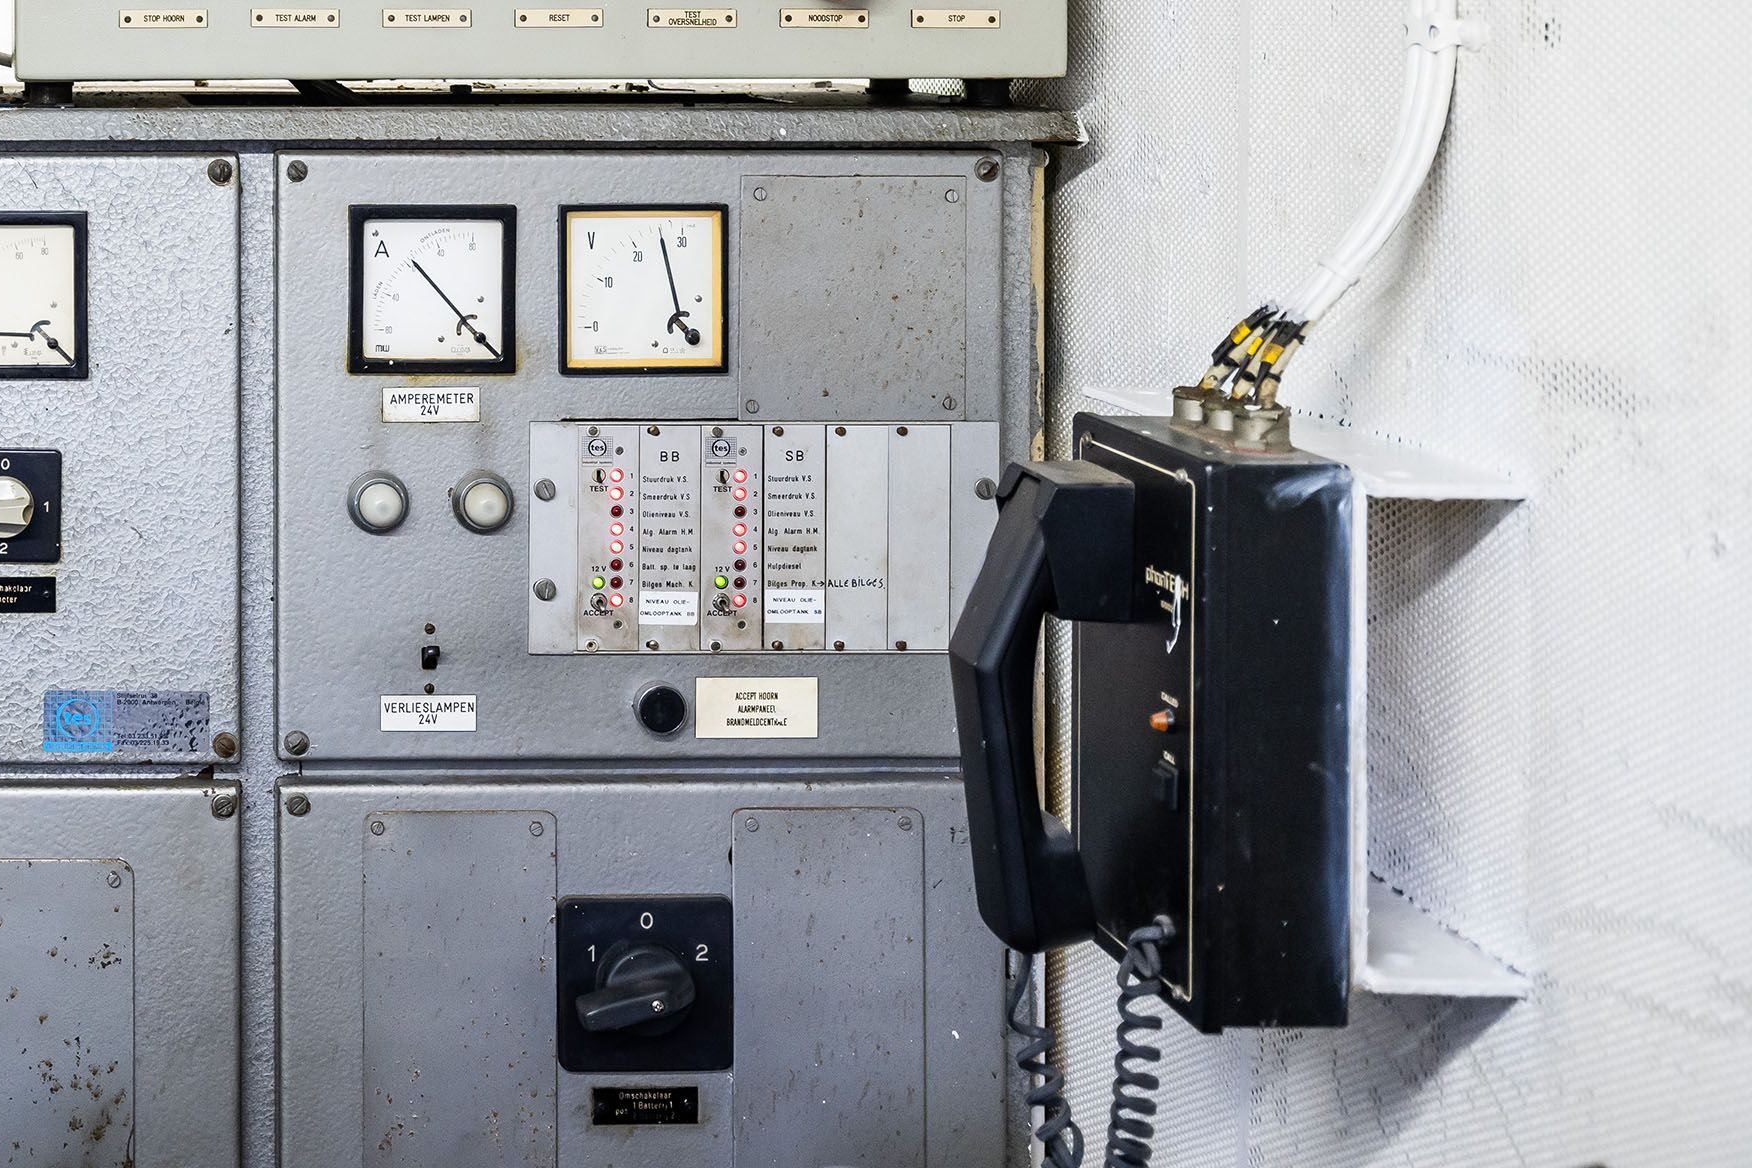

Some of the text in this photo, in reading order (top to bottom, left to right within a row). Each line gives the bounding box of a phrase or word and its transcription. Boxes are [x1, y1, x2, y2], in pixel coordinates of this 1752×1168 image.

[143, 14, 185, 22] STOP HOORN
[276, 14, 316, 22] TEST ALARM
[405, 14, 450, 22] TEST LAMPEN
[549, 14, 570, 22] RESET
[684, 11, 701, 19] TEST
[808, 14, 842, 22] NOODSTOP
[948, 14, 965, 22] STOP
[668, 18, 717, 26] OVERSNELHEID
[420, 228, 450, 243] ONTLADEN
[588, 232, 595, 249] V
[677, 237, 687, 247] 30
[375, 240, 389, 257] A
[437, 249, 444, 257] 40
[16, 252, 23, 260] 60
[633, 251, 643, 262] 20
[604, 277, 613, 288] 10
[372, 281, 383, 300] LADEN
[385, 326, 392, 334] 80
[593, 321, 598, 332] 0
[390, 394, 474, 404] AMPEREMETER
[421, 406, 440, 416] 24V
[591, 443, 604, 451] tes
[1, 458, 10, 470] 0
[44, 501, 49, 512] 1
[0, 543, 8, 554] 2
[667, 546, 692, 554] dagtank
[642, 581, 662, 589] Bilges
[768, 580, 788, 589] Bilges
[828, 579, 849, 587] ALLE
[1146, 565, 1188, 600] phonTEH
[735, 692, 778, 700] ACCEPT HOORN
[384, 702, 474, 713] VERLIESLAMPEN
[419, 714, 438, 724] 24V
[640, 912, 653, 929] 0
[588, 944, 595, 962] 1
[696, 944, 709, 961] 2
[619, 1092, 672, 1100] Omschakelaar
